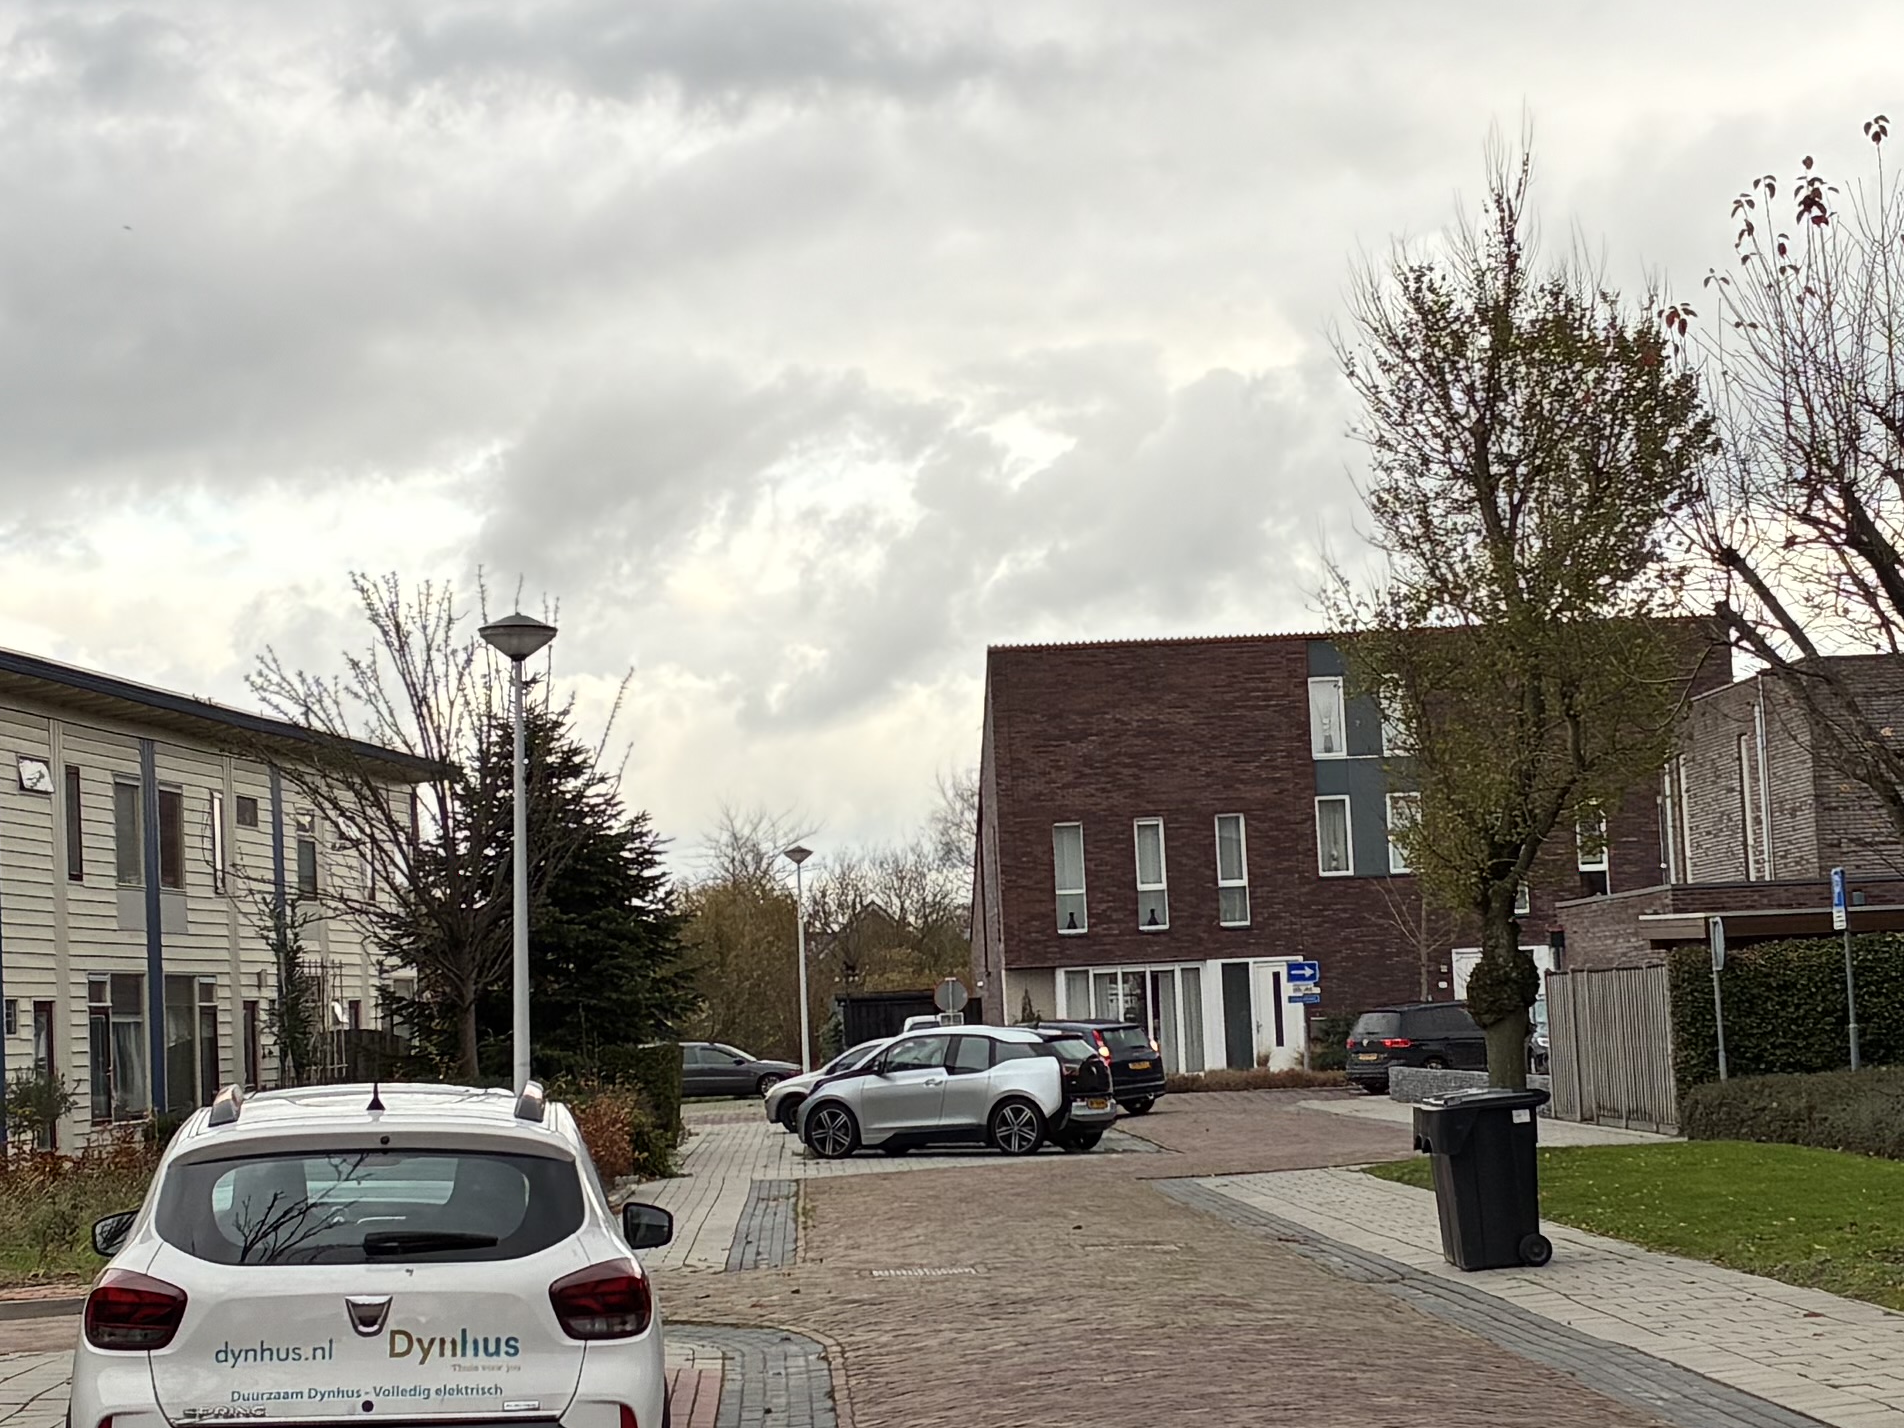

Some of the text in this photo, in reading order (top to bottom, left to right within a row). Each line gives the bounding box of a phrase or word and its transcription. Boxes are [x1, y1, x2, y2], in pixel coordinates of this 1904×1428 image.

[214, 1338, 333, 1369] dynhus.nl
[389, 1327, 520, 1366] Dynhus
[231, 1390, 304, 1403] Duurzaam
[307, 1387, 362, 1402] Dynhus
[372, 1385, 431, 1400] Volledig
[434, 1383, 503, 1397] elektrisch
